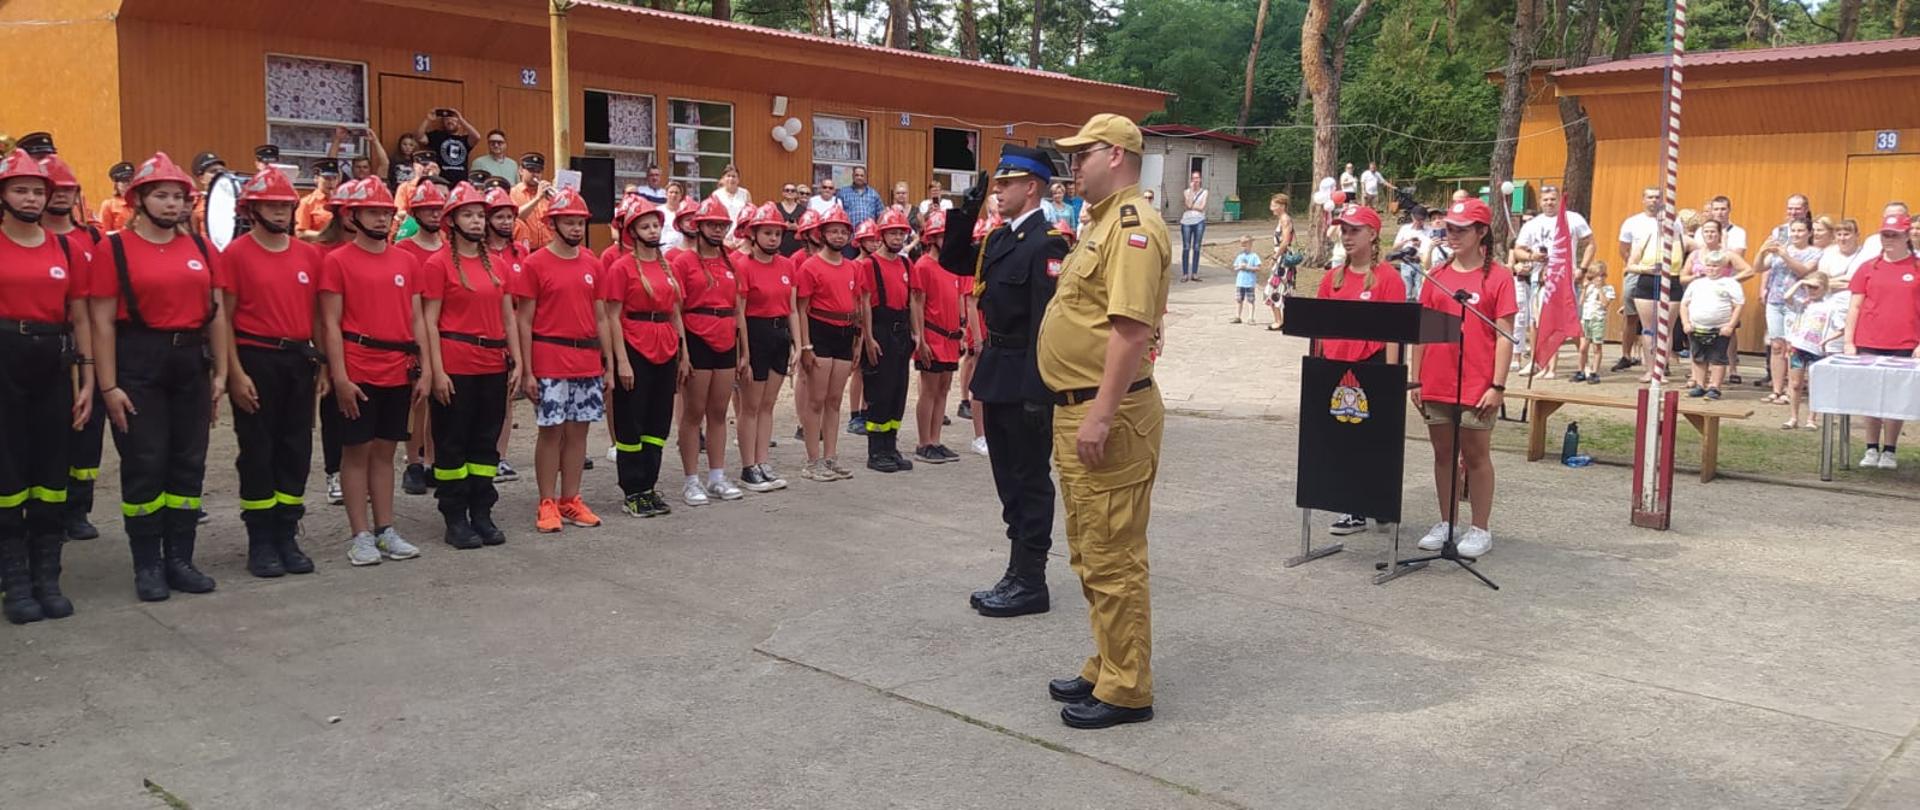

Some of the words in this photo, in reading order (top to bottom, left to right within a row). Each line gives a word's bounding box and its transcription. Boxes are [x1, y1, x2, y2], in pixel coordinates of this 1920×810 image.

[416, 55, 430, 71] 31
[522, 69, 536, 85] 32
[1878, 132, 1897, 149] 39
